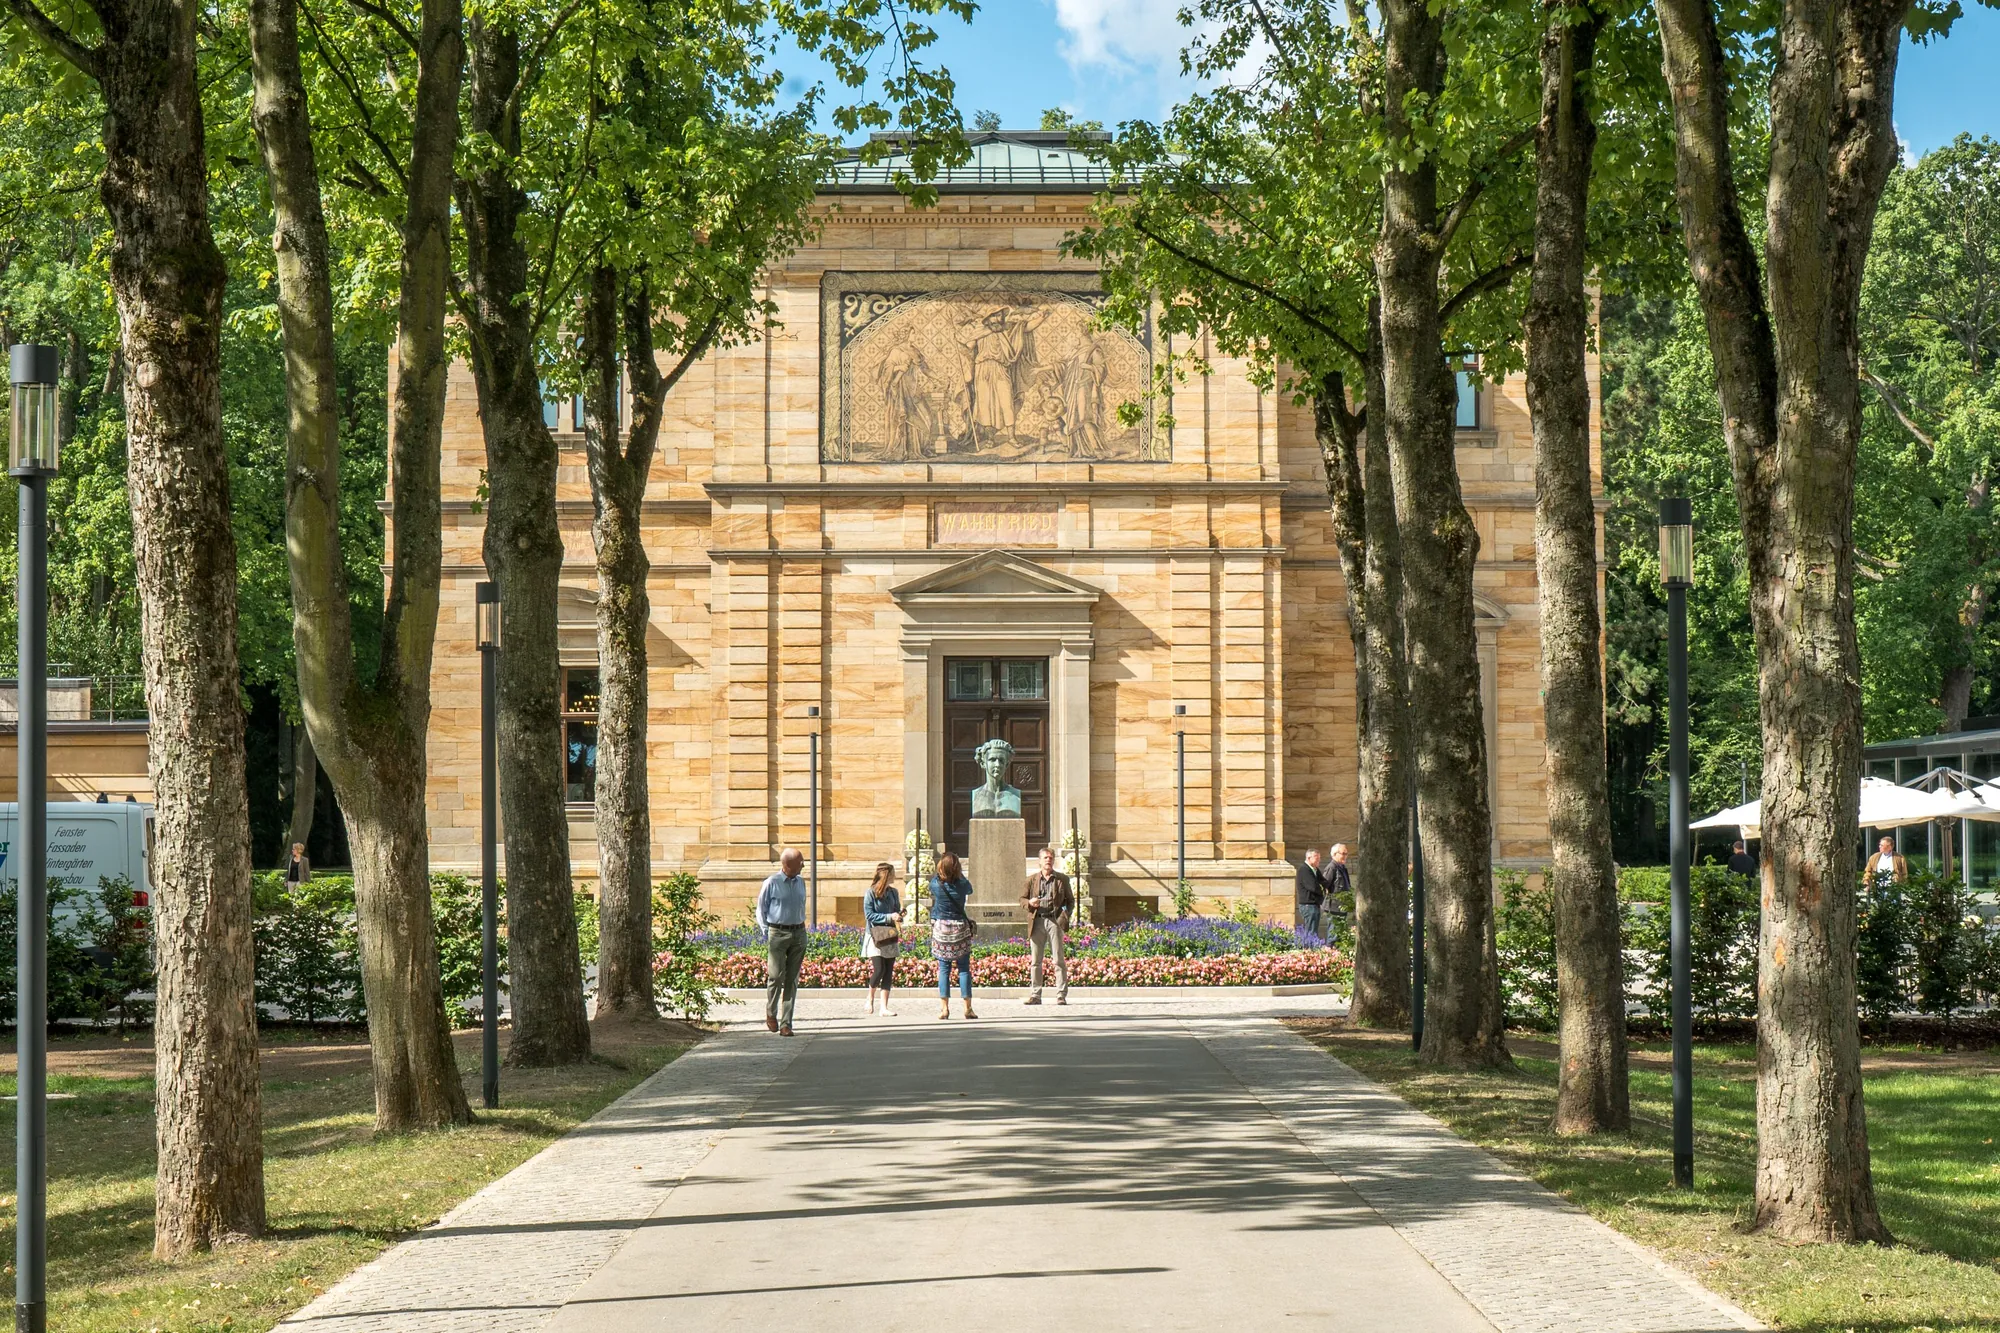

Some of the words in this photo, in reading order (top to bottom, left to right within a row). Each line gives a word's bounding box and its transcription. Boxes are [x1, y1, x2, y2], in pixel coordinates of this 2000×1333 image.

[942, 513, 1052, 536] WAHNFRIED
[54, 826, 87, 837] Fenster
[46, 841, 87, 853] Fassaden
